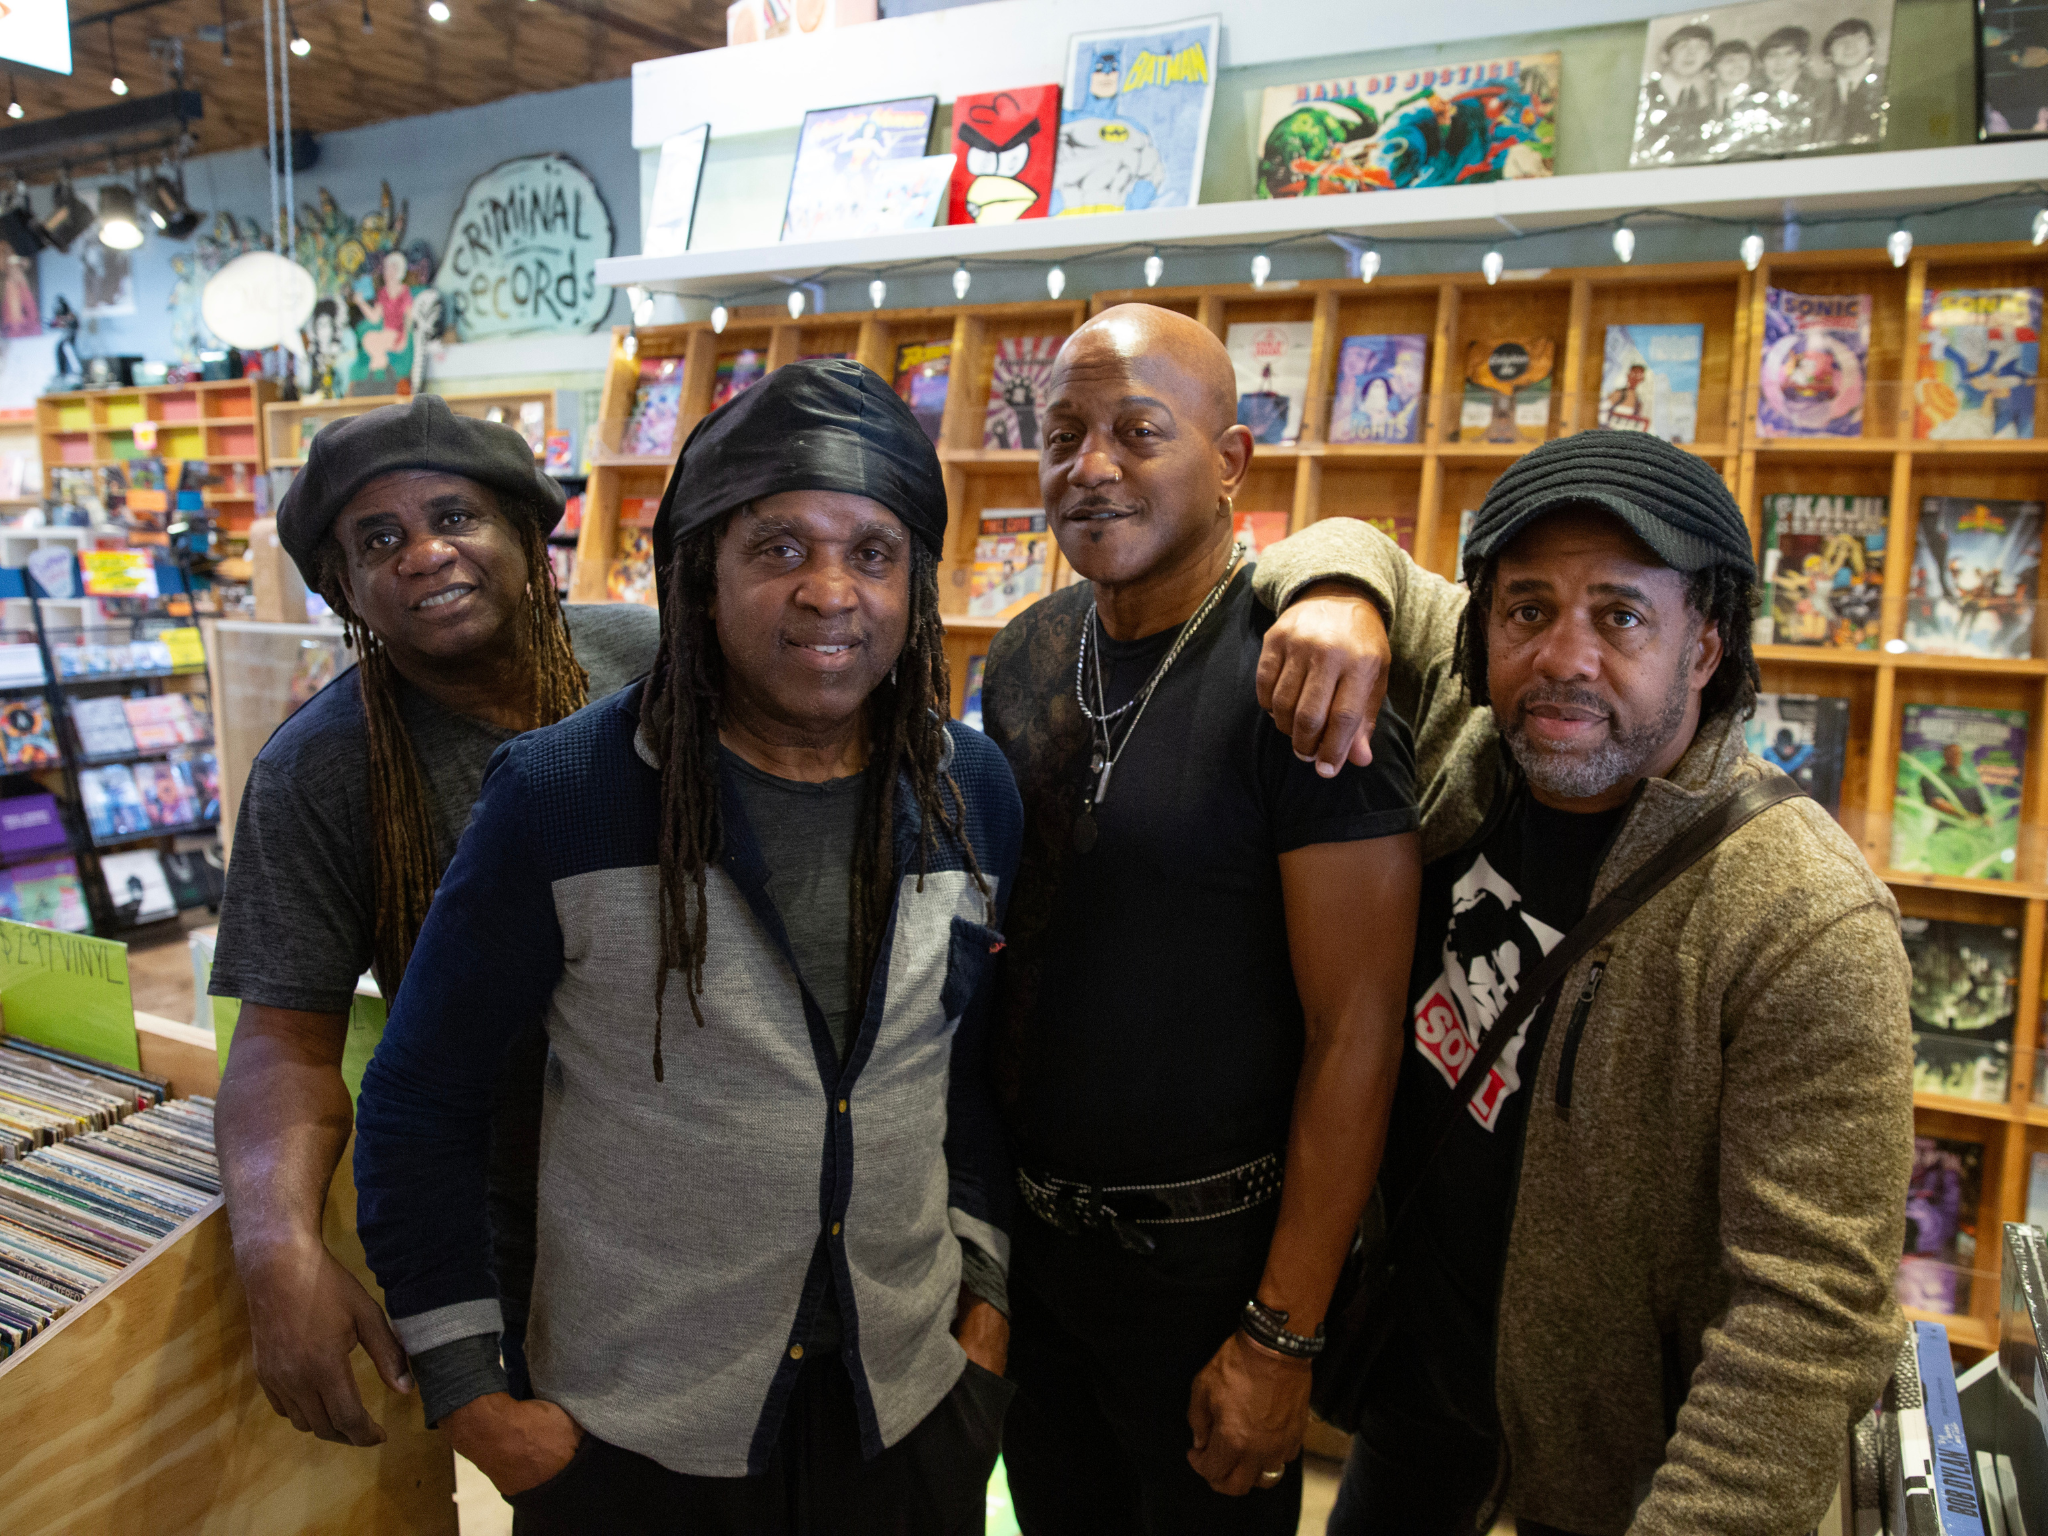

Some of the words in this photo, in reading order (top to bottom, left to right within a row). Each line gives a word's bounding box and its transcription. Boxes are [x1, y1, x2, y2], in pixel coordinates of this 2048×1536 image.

[1122, 42, 1209, 94] BATMAN
[1295, 81, 1359, 102] HALL
[1367, 74, 1396, 96] OF
[1405, 60, 1520, 92] JUSTICE
[1784, 296, 1860, 318] SONIC
[58, 936, 125, 985] VINYL
[1415, 1005, 1491, 1119] SOL
[52, 1283, 81, 1303] STEREO
[1938, 1447, 1976, 1492] DYLAN
[1945, 1487, 1979, 1519] BOB
